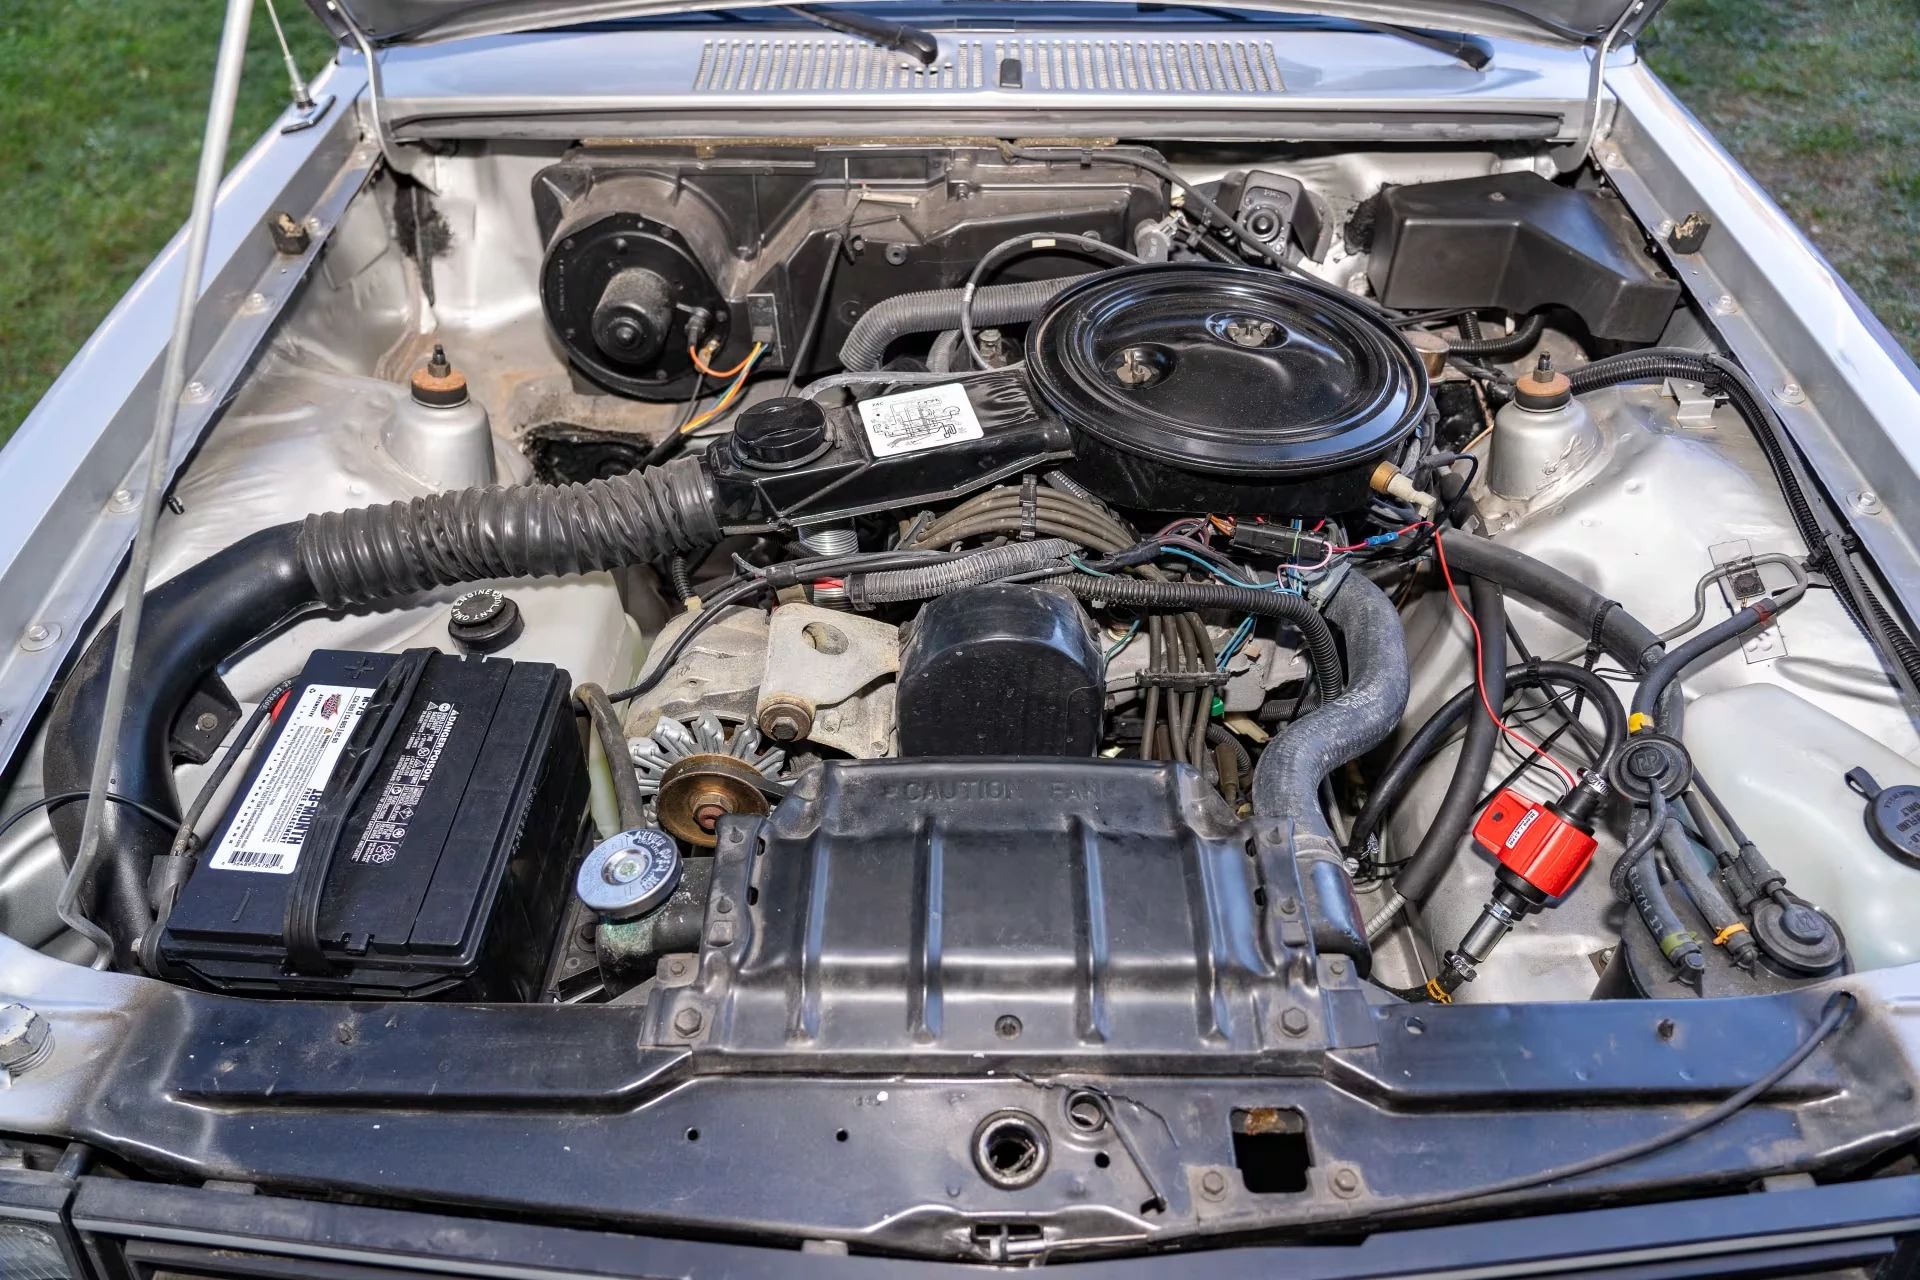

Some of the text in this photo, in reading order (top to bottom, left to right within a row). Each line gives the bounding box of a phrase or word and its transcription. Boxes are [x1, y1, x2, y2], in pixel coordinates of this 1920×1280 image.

[455, 588, 493, 607] ENGINE
[421, 715, 459, 781] DANGER/POISON
[906, 781, 1021, 802] CAUTION
[279, 803, 304, 843] REPLACEMENT
[286, 788, 325, 844] 18-MONTH
